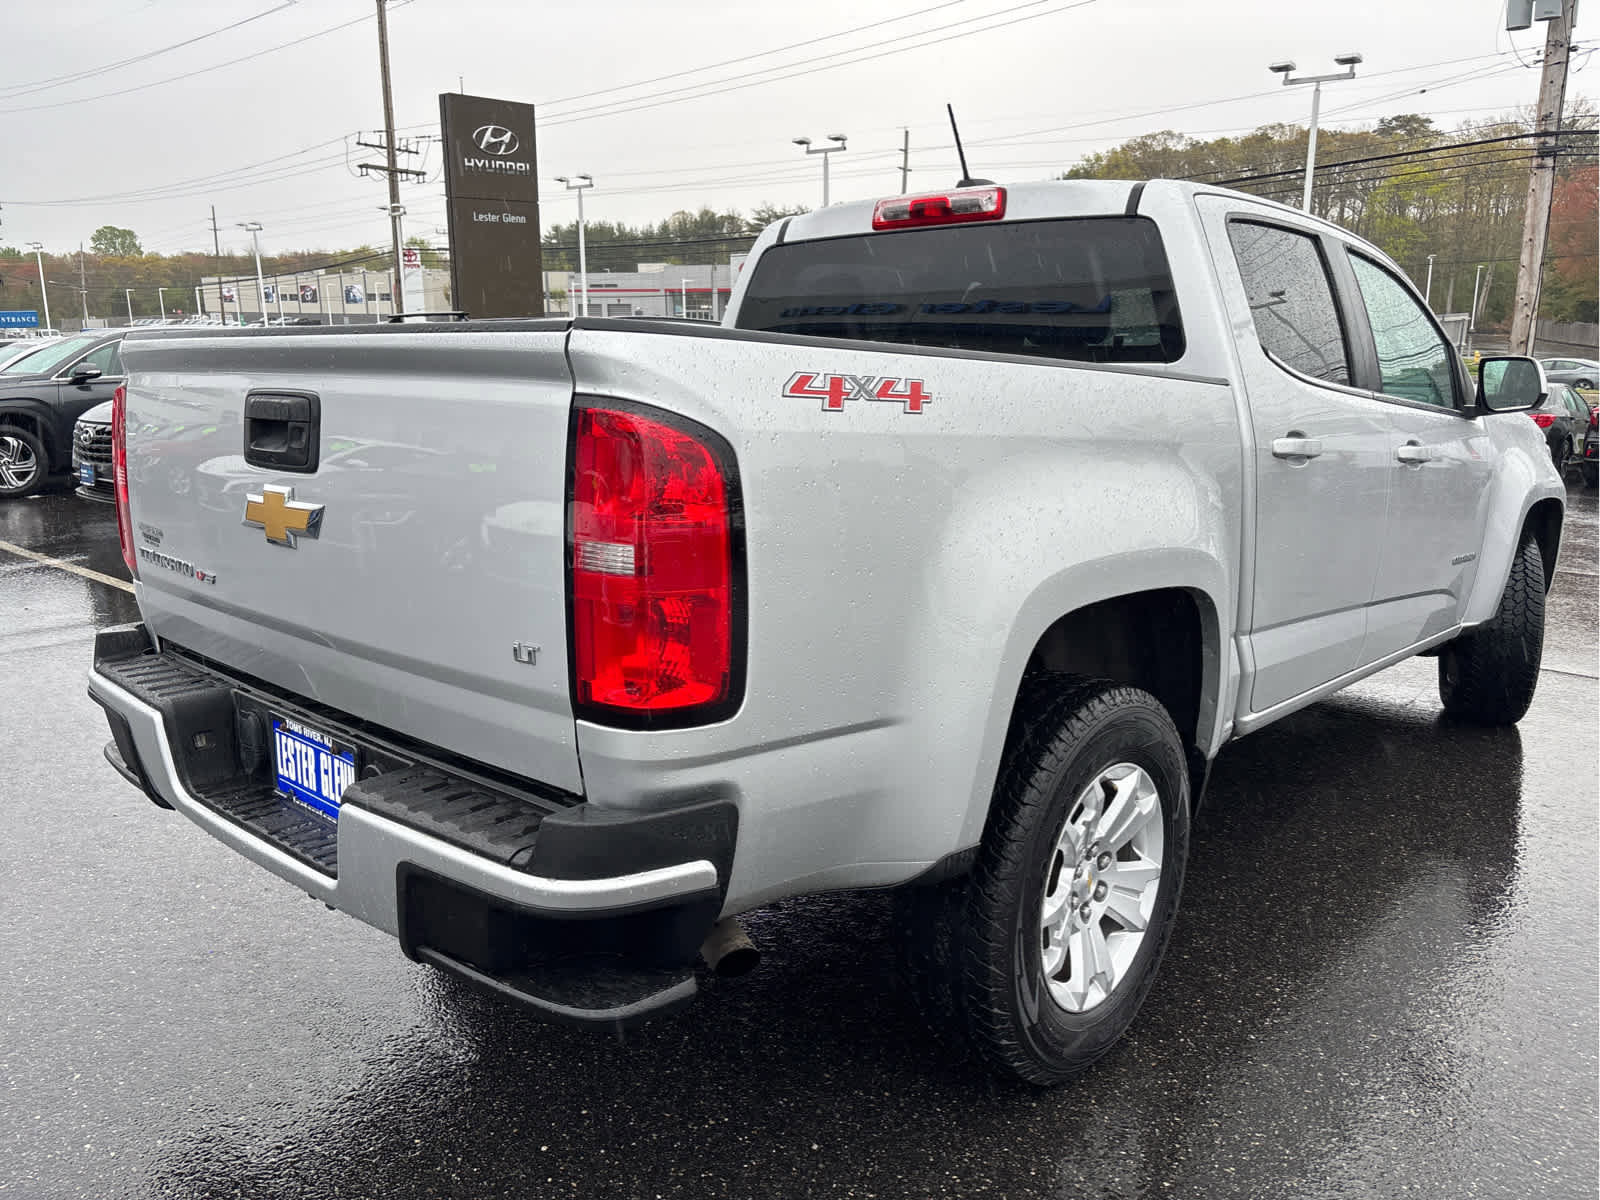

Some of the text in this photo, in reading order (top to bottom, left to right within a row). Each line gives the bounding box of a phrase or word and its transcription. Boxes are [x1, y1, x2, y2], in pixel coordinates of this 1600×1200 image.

[464, 157, 530, 176] HYUNDAI
[473, 211, 526, 224] Lester Glenn
[512, 640, 541, 666] LT
[275, 731, 317, 792] LESTER
